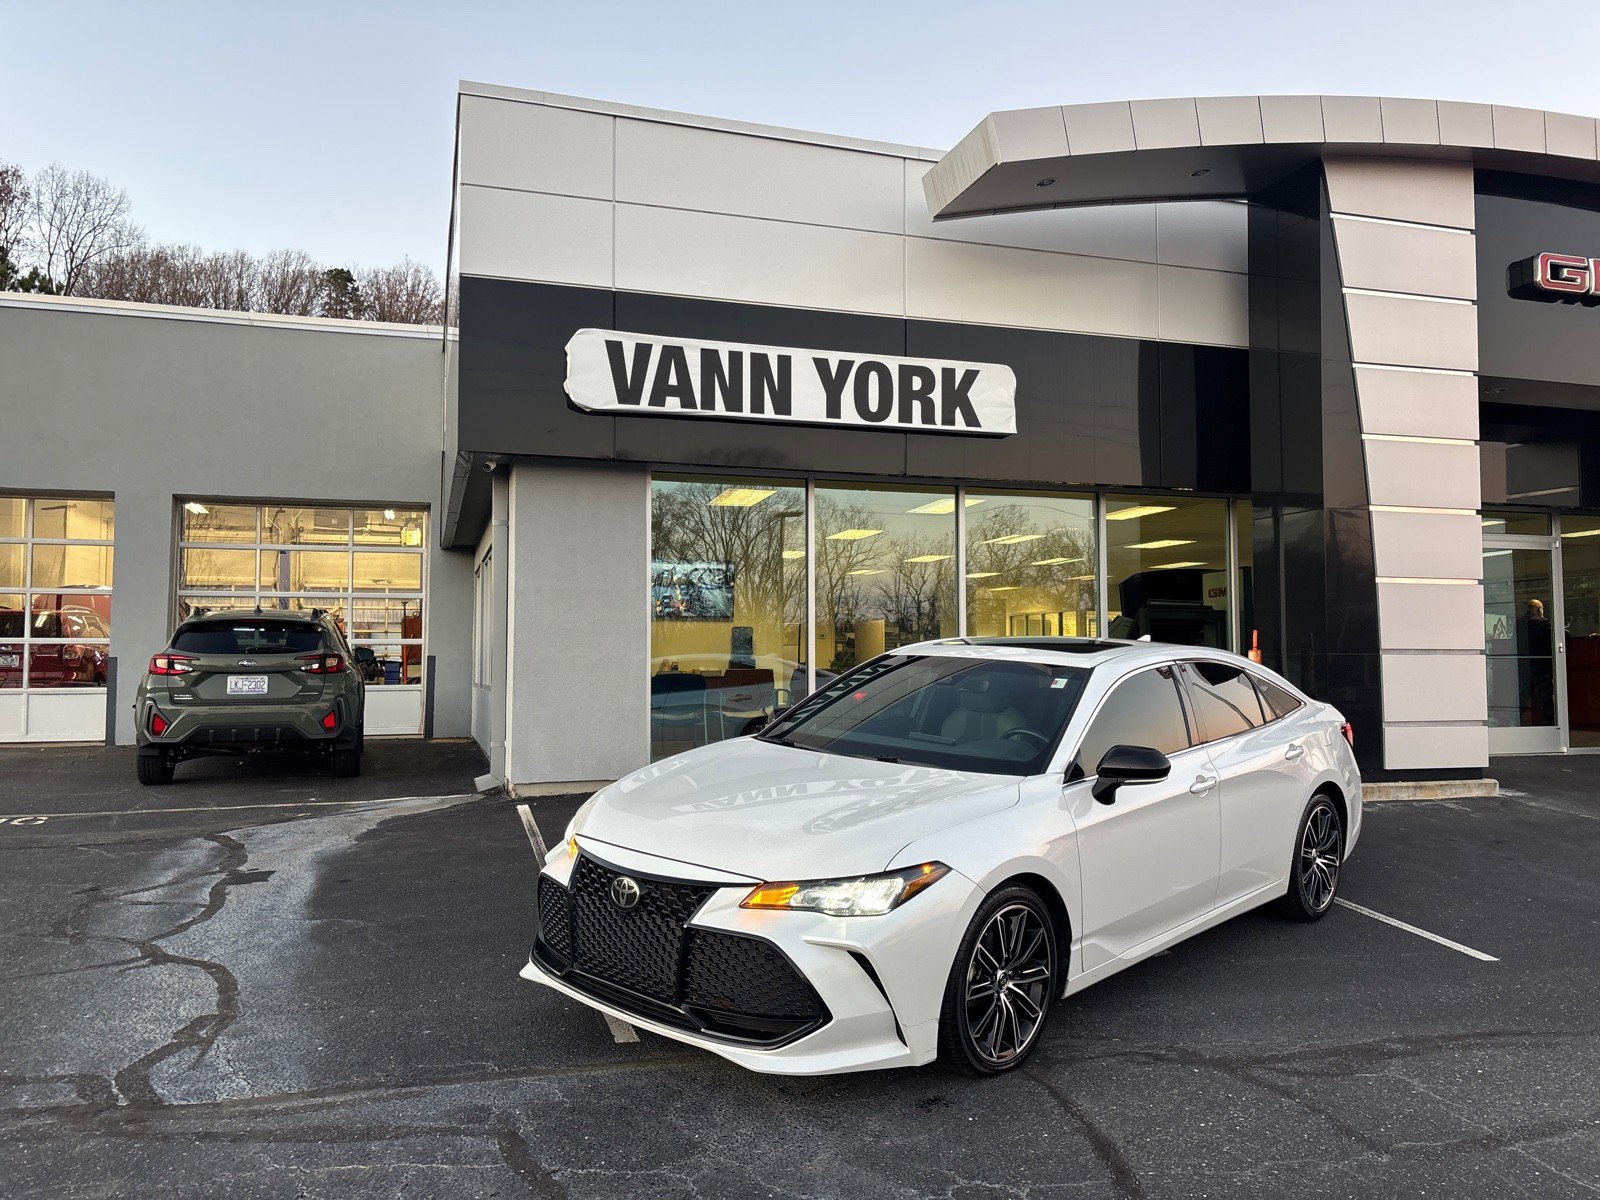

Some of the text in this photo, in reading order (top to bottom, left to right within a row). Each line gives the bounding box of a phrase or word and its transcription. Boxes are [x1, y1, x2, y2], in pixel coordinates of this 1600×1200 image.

[605, 339, 982, 428] VANN YORK
[1208, 586, 1226, 598] GM
